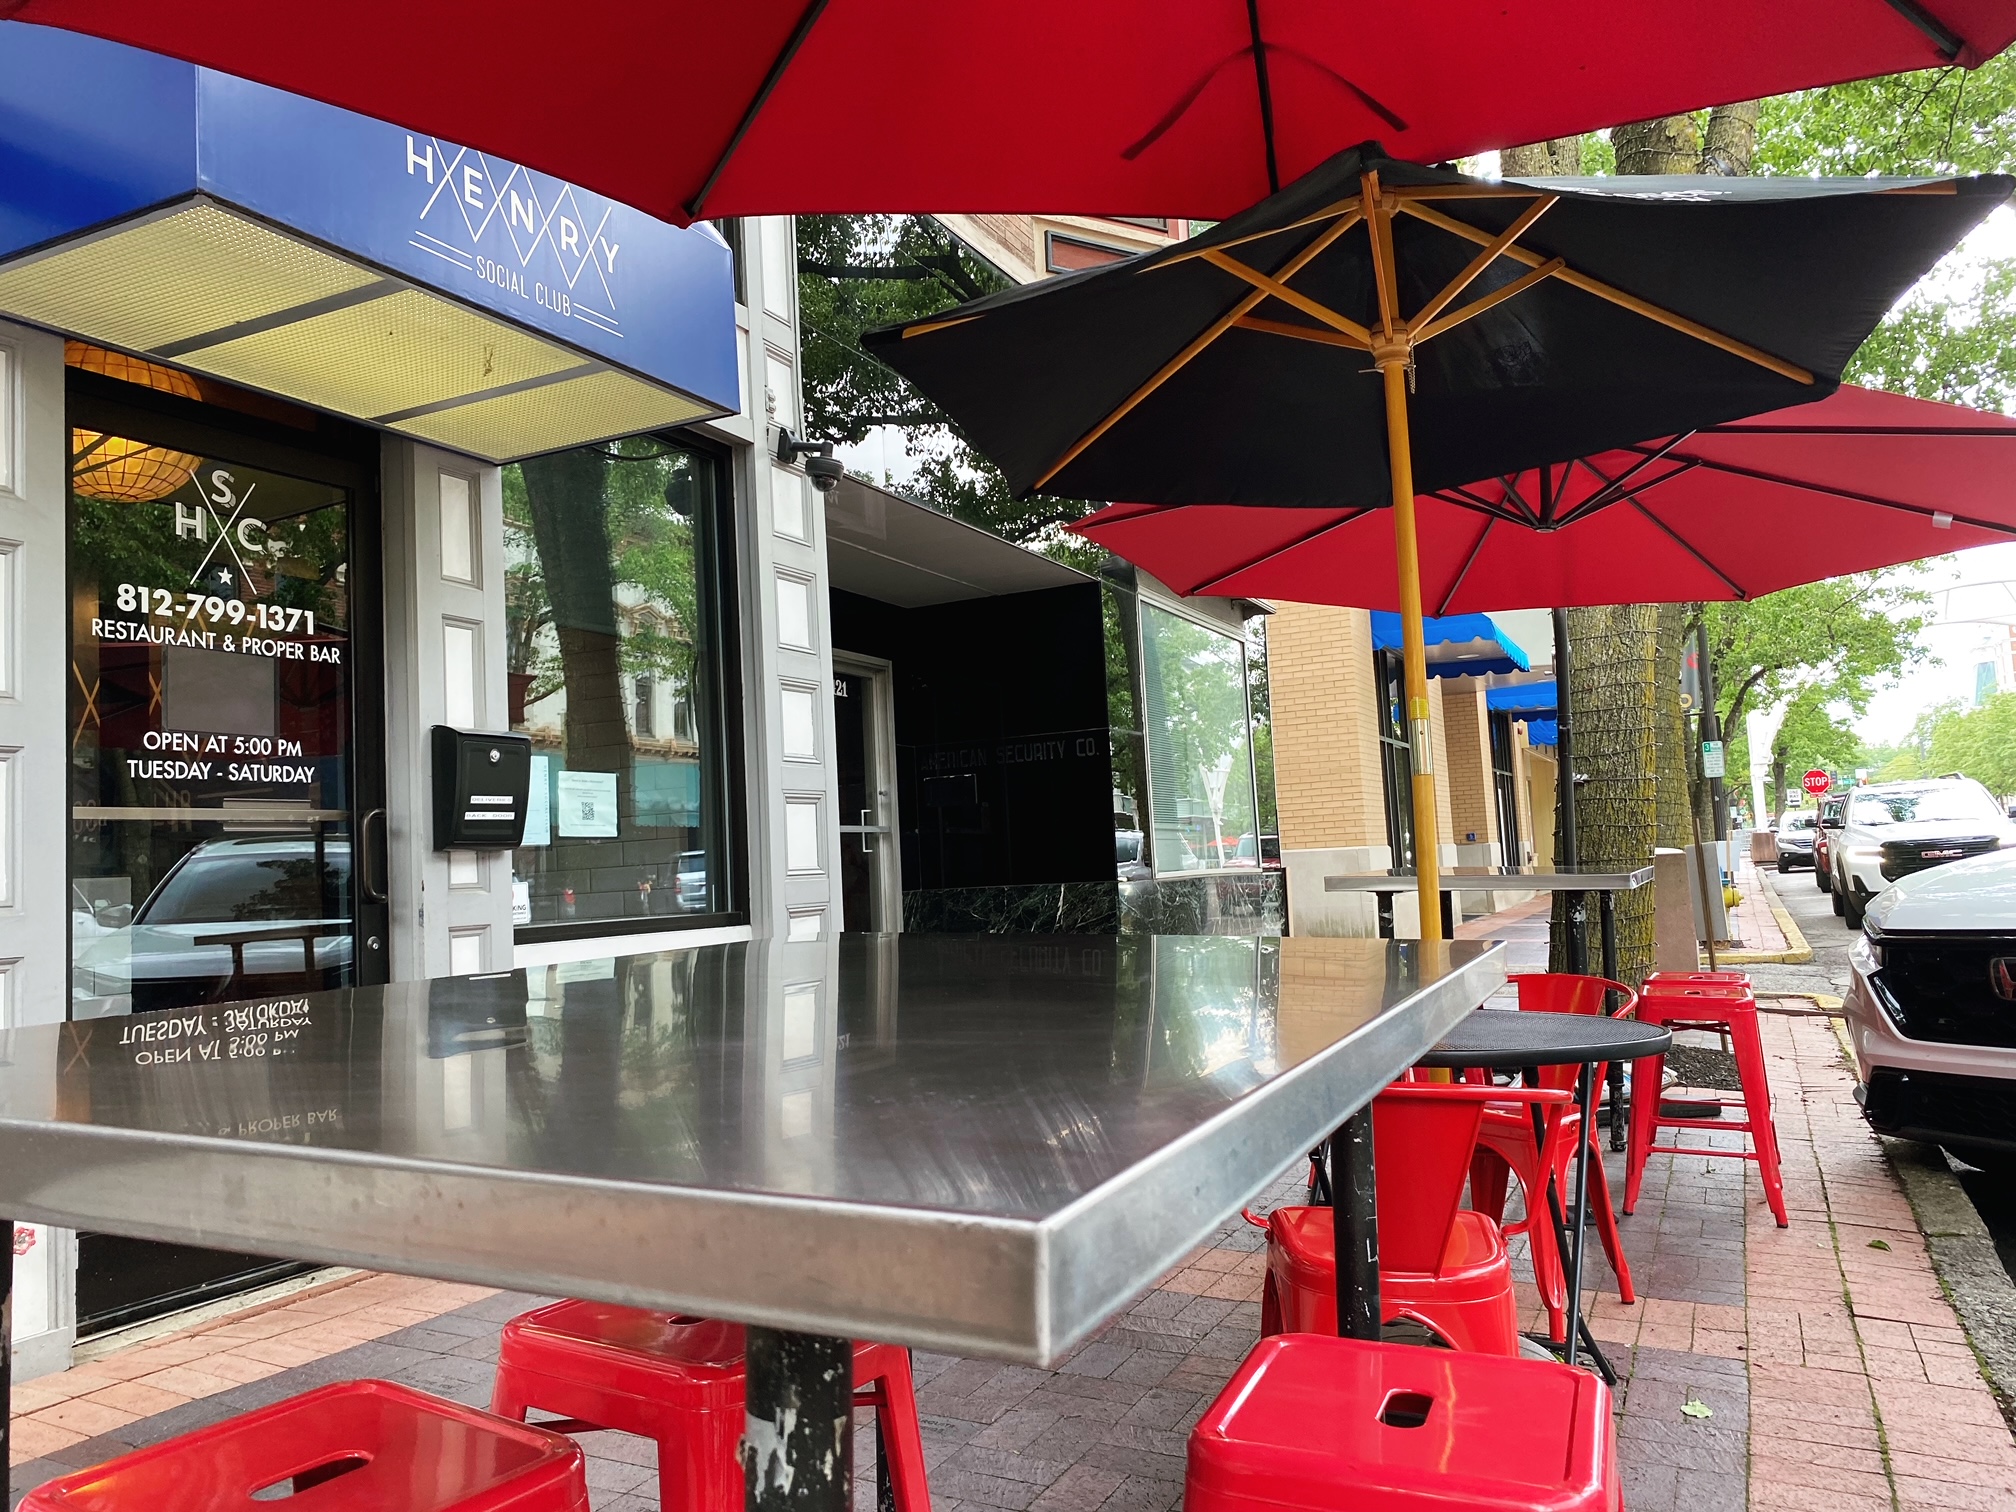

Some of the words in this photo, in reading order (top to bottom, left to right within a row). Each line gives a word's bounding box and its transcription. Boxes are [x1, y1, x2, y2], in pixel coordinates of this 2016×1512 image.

[406, 134, 620, 274] HENRY
[476, 255, 530, 299] SOCIAL
[535, 282, 571, 317] CLUB
[116, 583, 314, 635] 812-799-1371
[91, 618, 216, 649] RESTAURANT
[222, 634, 236, 652] &
[242, 636, 304, 660] PROPER
[310, 644, 341, 664] BAR
[834, 679, 849, 697] 21
[143, 731, 199, 751] OPEN
[204, 735, 228, 753] AT
[233, 736, 272, 756] 5:00
[277, 739, 302, 757] PM
[996, 740, 1066, 764] SECURITY
[1076, 737, 1100, 757] CO.
[127, 759, 212, 780] TUESDAY
[228, 763, 315, 784] SATURDAY
[1804, 776, 1828, 787] STOP
[1921, 849, 1962, 858] GMC
